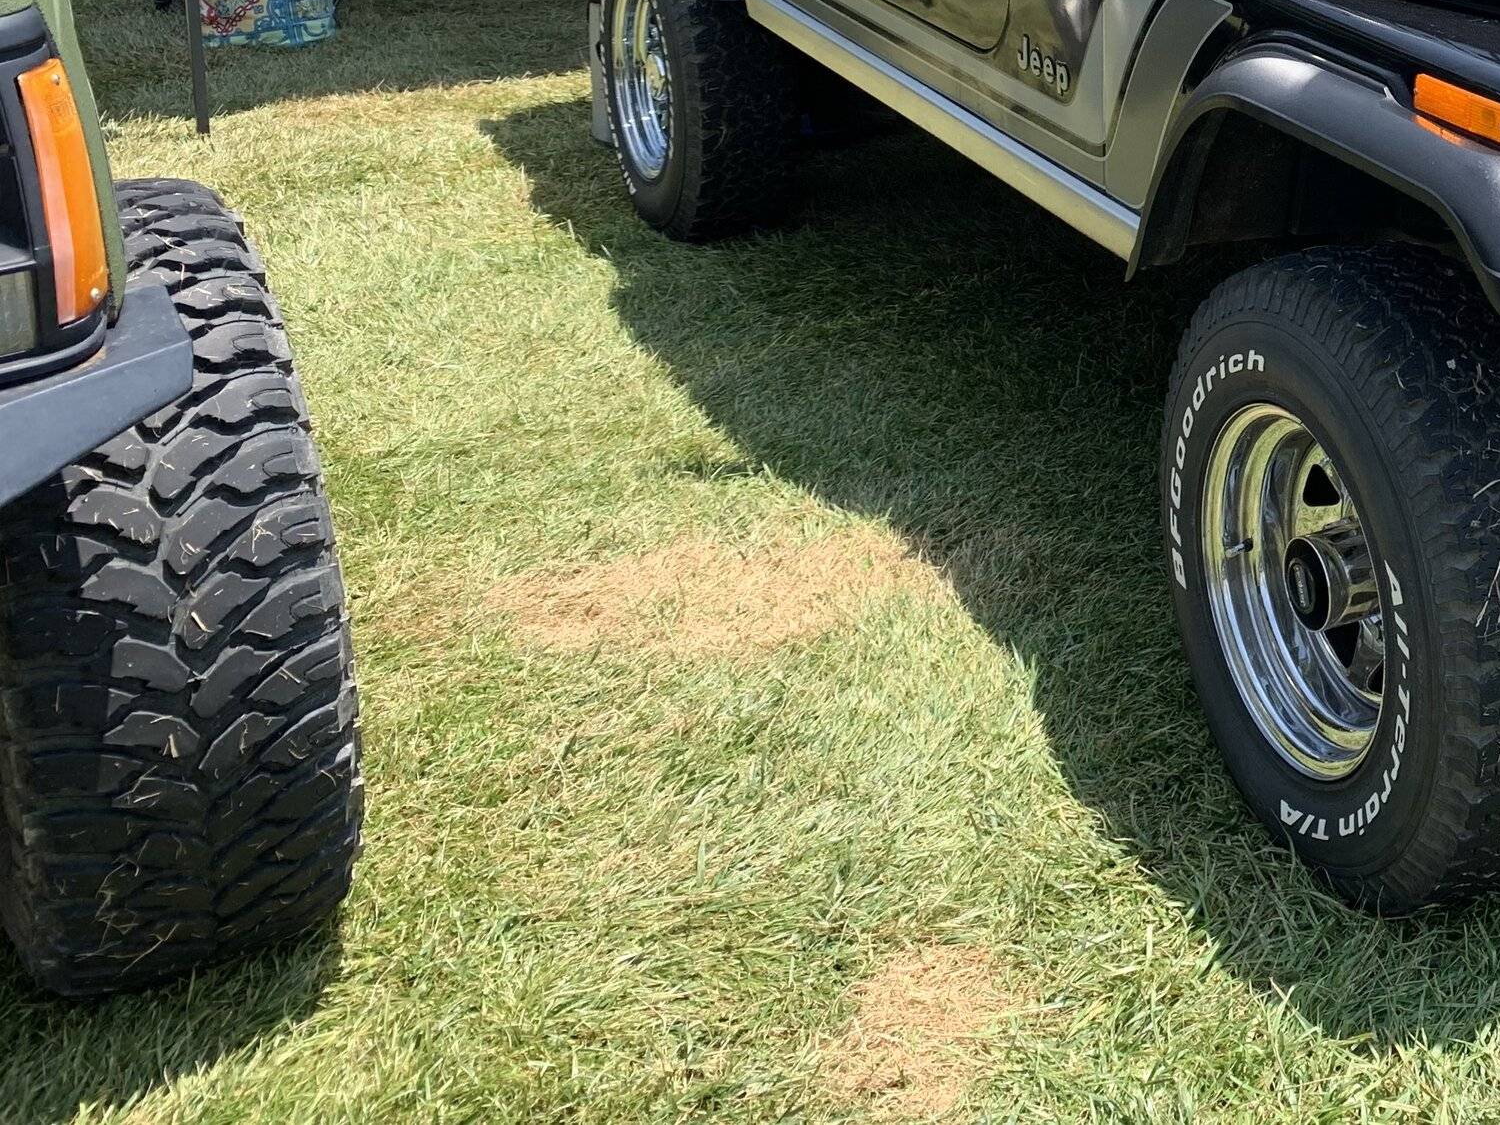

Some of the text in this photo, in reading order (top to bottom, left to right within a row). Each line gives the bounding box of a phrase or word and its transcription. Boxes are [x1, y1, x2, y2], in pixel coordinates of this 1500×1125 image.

[1017, 33, 1070, 96] Jeep
[1170, 349, 1265, 590] BFGoodrich
[1280, 799, 1330, 841] T/A
